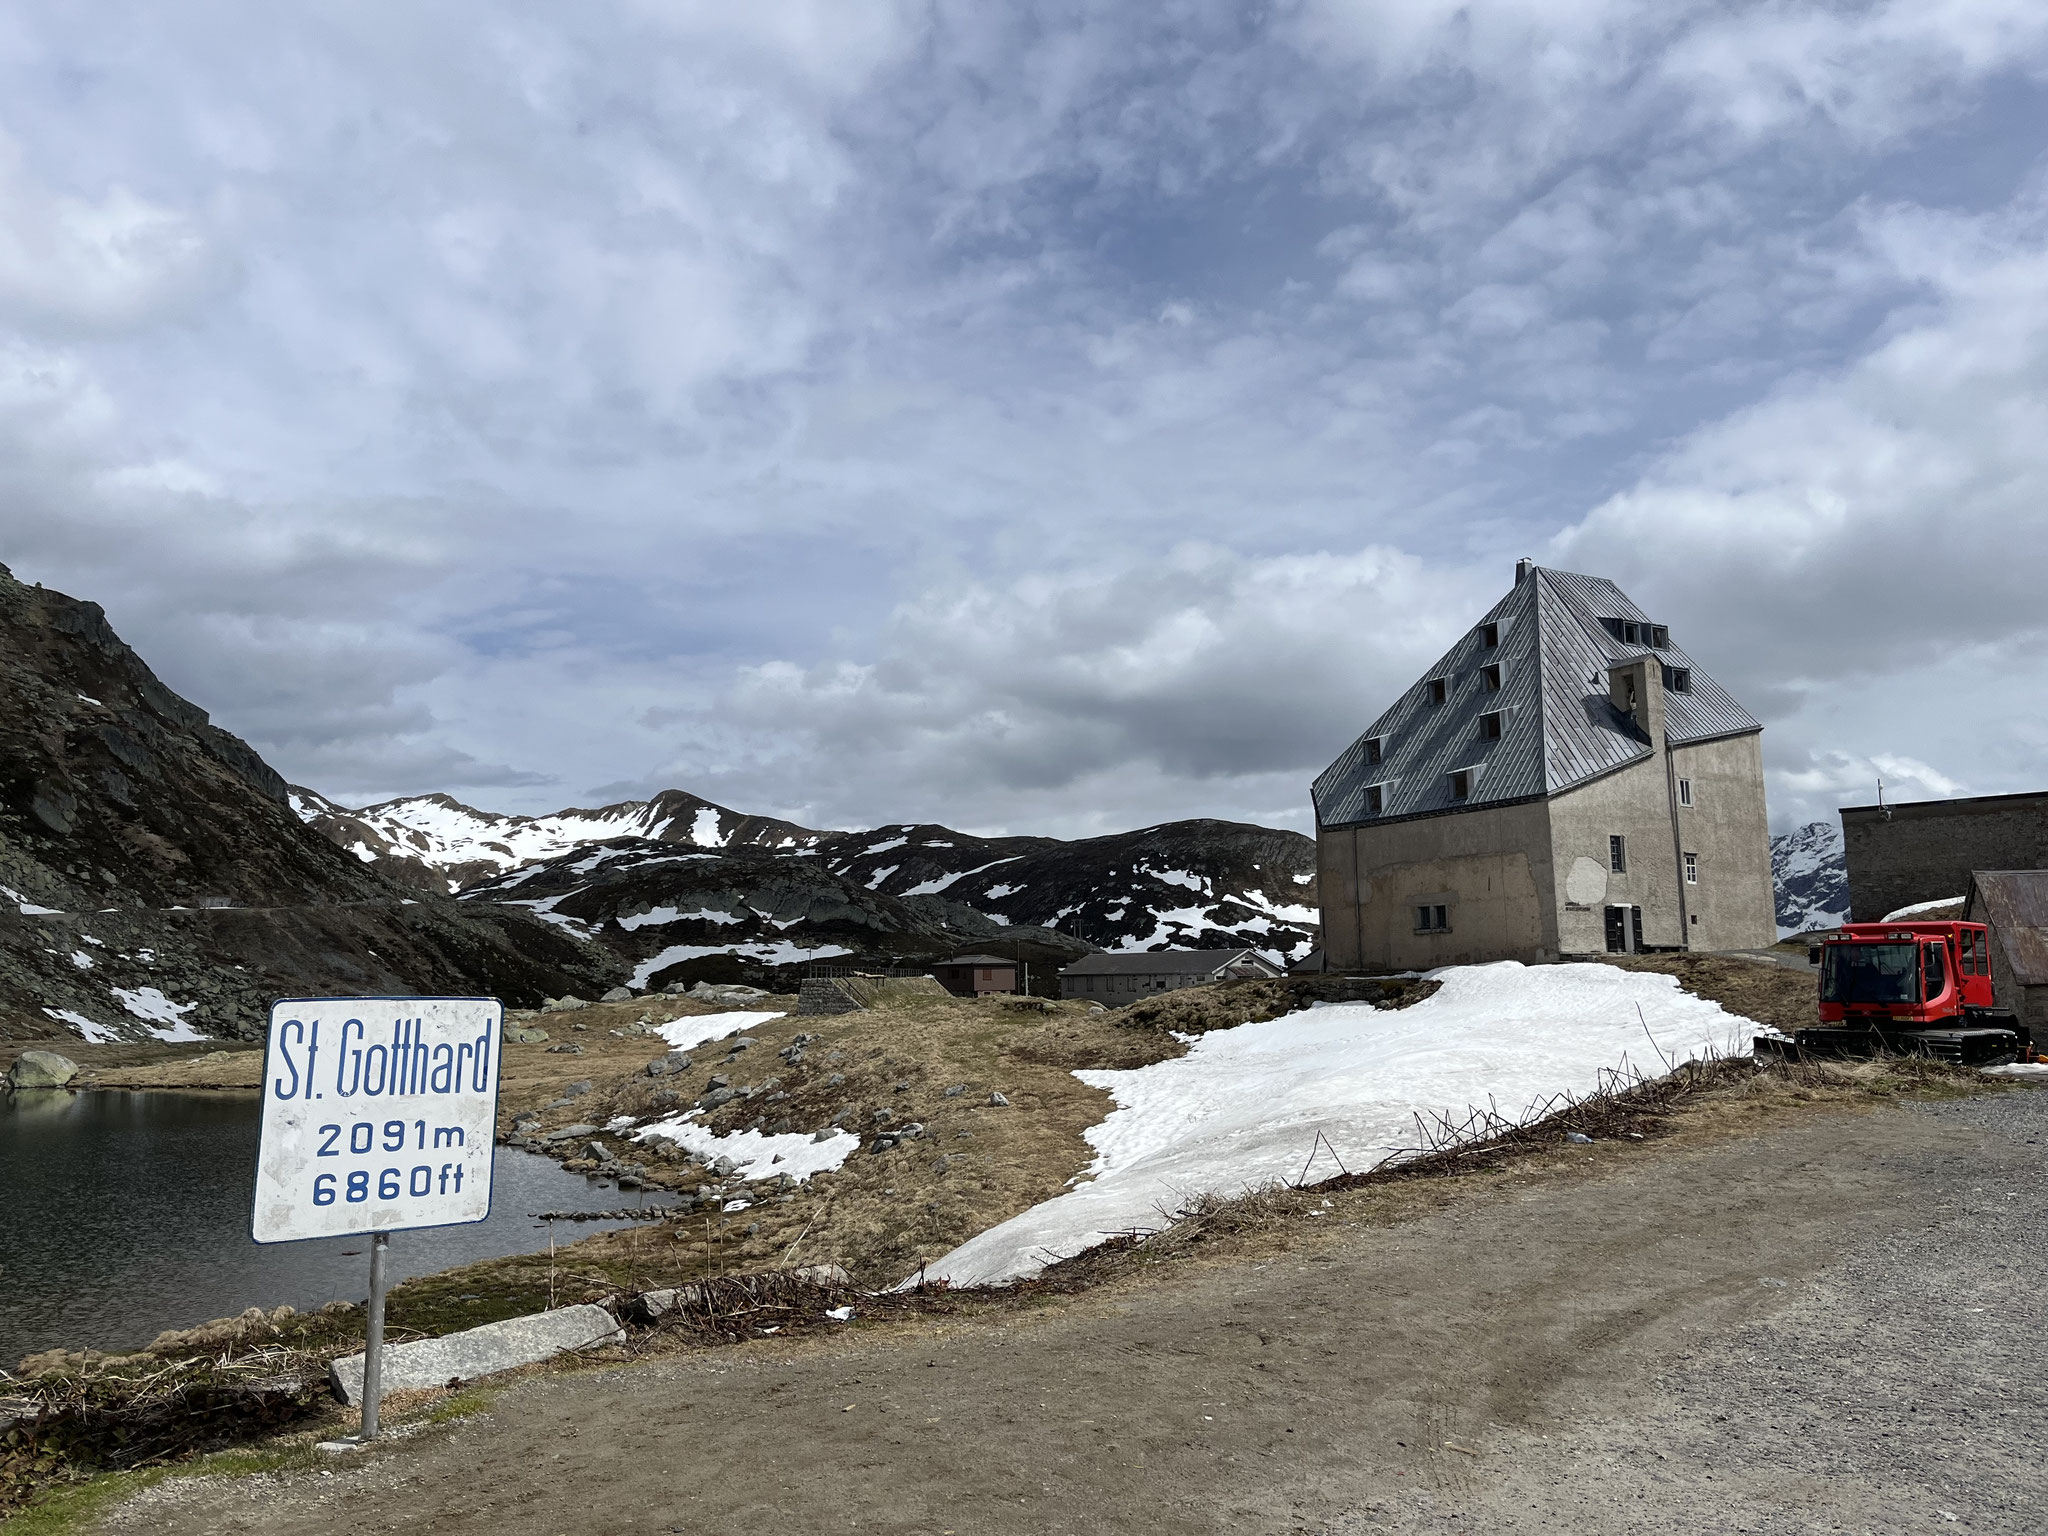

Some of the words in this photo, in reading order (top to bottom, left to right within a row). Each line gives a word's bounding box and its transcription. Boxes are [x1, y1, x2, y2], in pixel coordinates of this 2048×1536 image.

[275, 1020, 322, 1100] St.
[337, 1018, 492, 1097] Gotthard
[317, 1120, 464, 1157] 2091m
[313, 1163, 463, 1206] 6860ft
